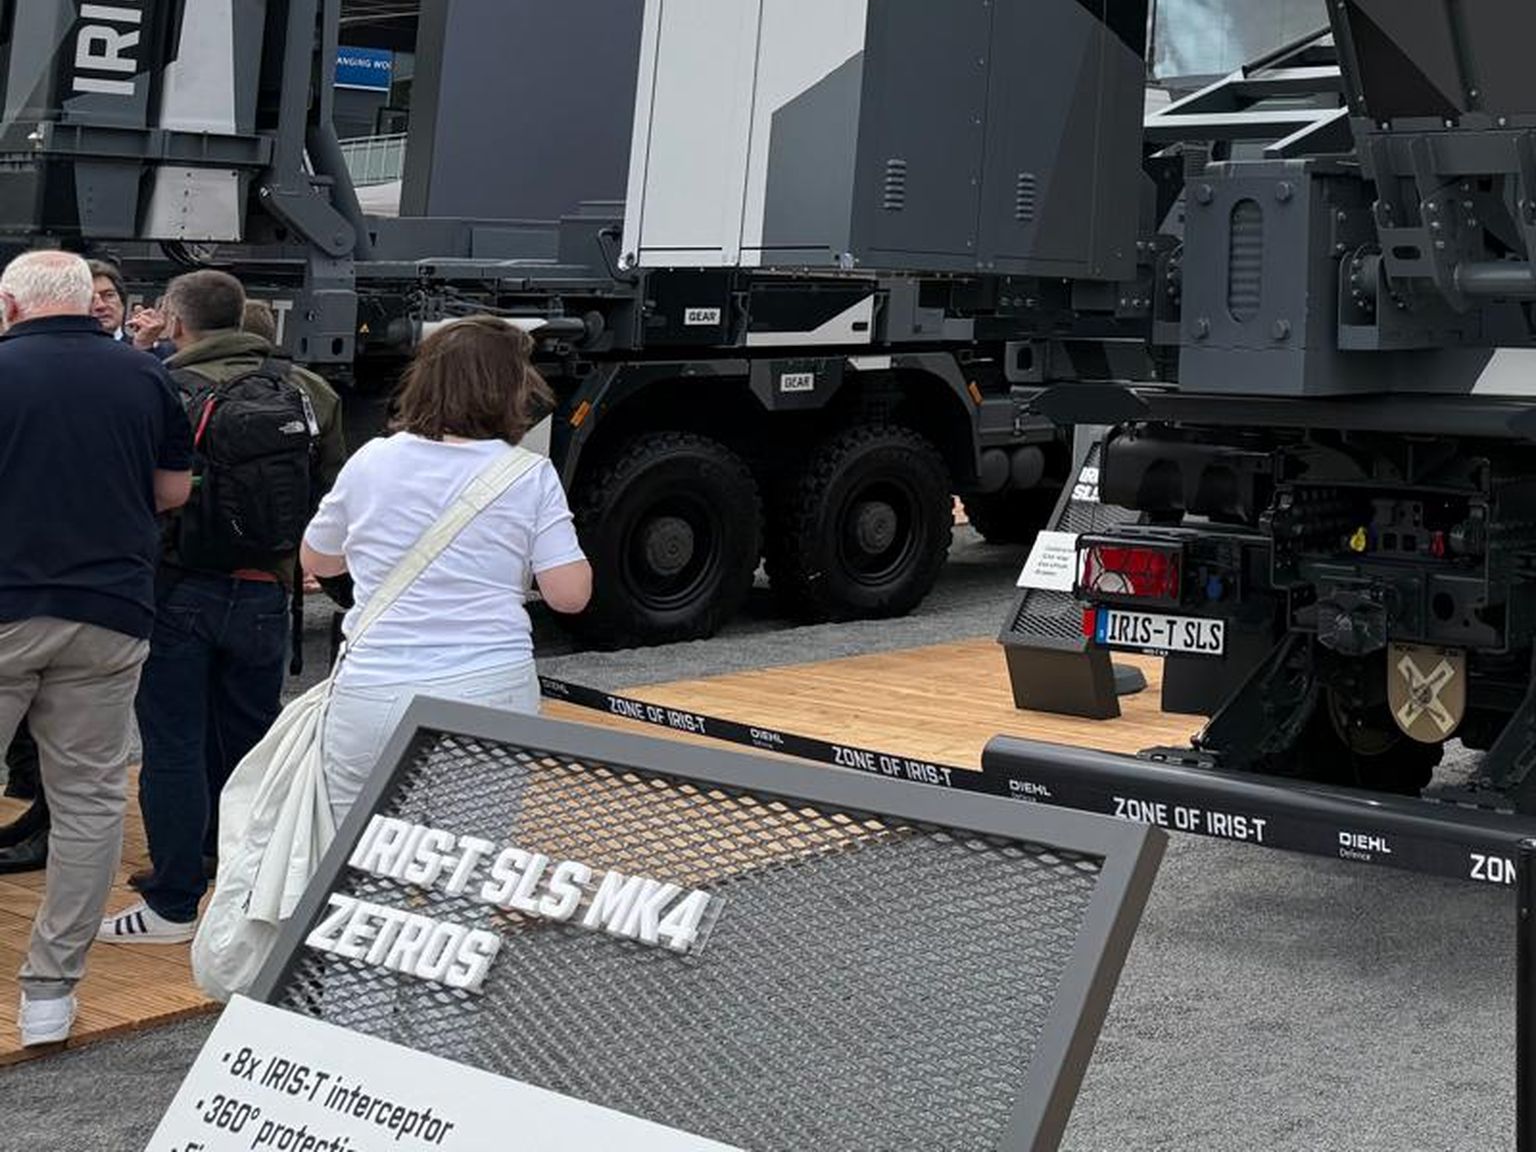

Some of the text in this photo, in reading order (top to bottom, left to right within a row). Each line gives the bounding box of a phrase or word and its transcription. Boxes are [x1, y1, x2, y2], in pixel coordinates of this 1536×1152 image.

[336, 56, 372, 68] ANGING
[688, 311, 718, 323] GEAR
[784, 376, 811, 389] GEAR
[1108, 614, 1222, 651] IRIS-T SLS
[607, 696, 706, 734] ZONE OF IRIS-T
[832, 746, 953, 786] ZONE OF IRIS-T
[1009, 779, 1052, 797] DIEHL
[1112, 796, 1266, 843] ZONE OF IRIS-T
[1338, 832, 1392, 854] DIEHL
[347, 813, 711, 952] IRIS-T SLS MK4
[1470, 853, 1517, 884] ZON
[305, 892, 501, 992] ZETROS
[203, 1094, 261, 1134] 360°
[230, 1047, 455, 1147] 8x IRIS-T interceptor
